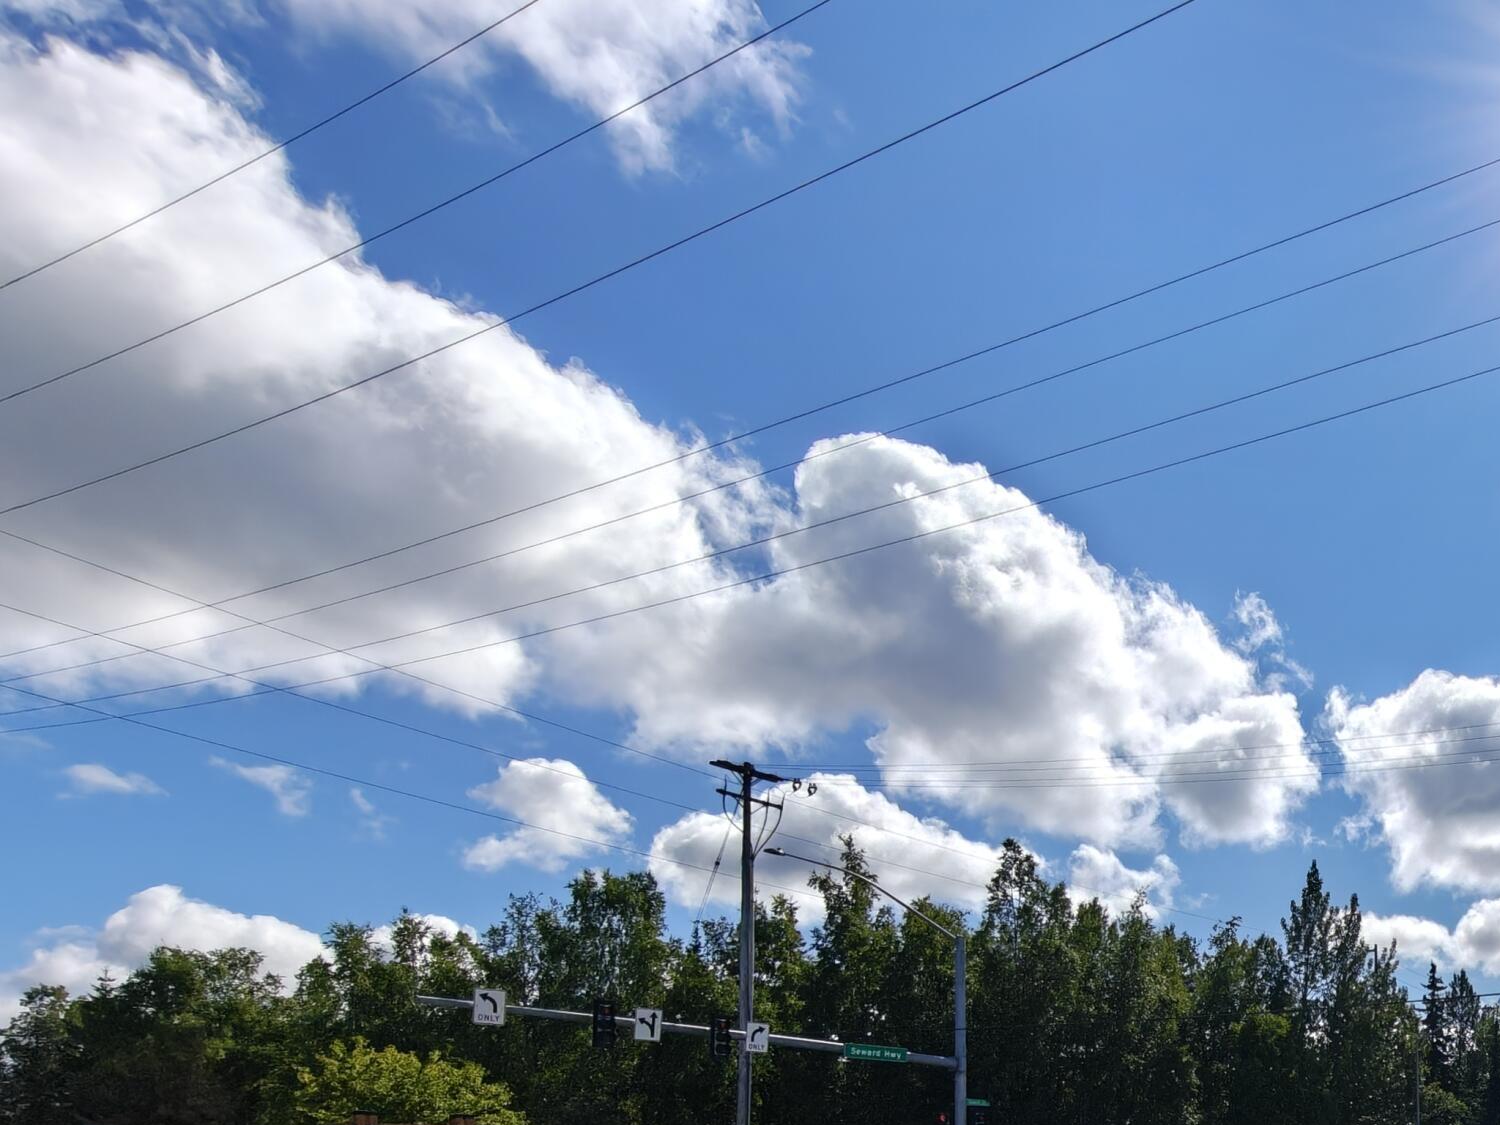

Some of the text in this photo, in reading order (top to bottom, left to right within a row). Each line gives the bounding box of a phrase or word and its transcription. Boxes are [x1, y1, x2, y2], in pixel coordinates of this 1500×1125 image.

[478, 1014, 500, 1022] ONLY
[851, 1047, 902, 1059] Seward Hwy
